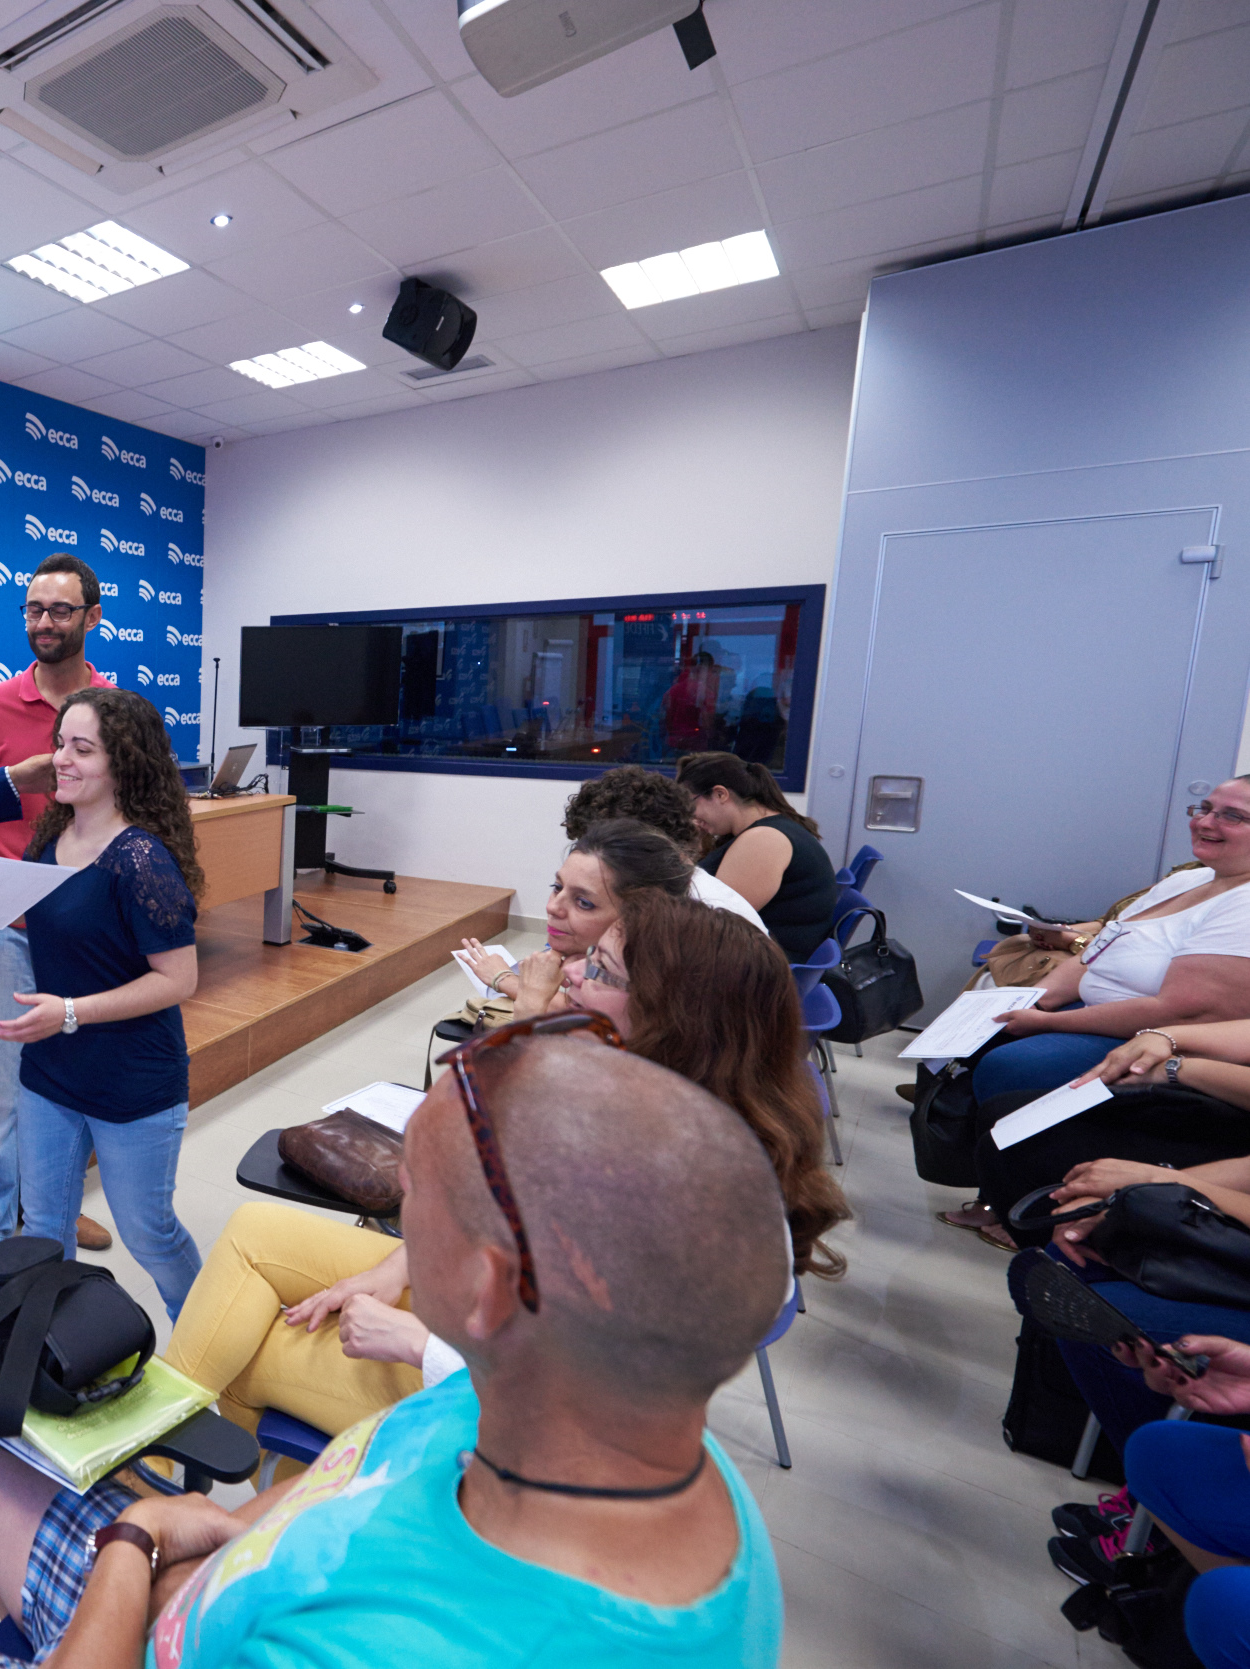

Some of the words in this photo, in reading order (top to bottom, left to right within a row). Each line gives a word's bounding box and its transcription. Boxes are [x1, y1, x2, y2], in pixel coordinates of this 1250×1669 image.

[47, 428, 78, 450] ecca
[120, 449, 146, 469] ecca
[14, 470, 47, 491] ecca
[91, 489, 119, 508] ecca
[160, 506, 184, 523] ecca
[47, 527, 78, 545] ecca
[119, 540, 145, 557] ecca
[159, 591, 182, 605] ecca
[119, 628, 144, 642] ecca
[182, 633, 203, 646] ecca
[157, 673, 180, 686] ecca
[180, 712, 201, 725] ecca
